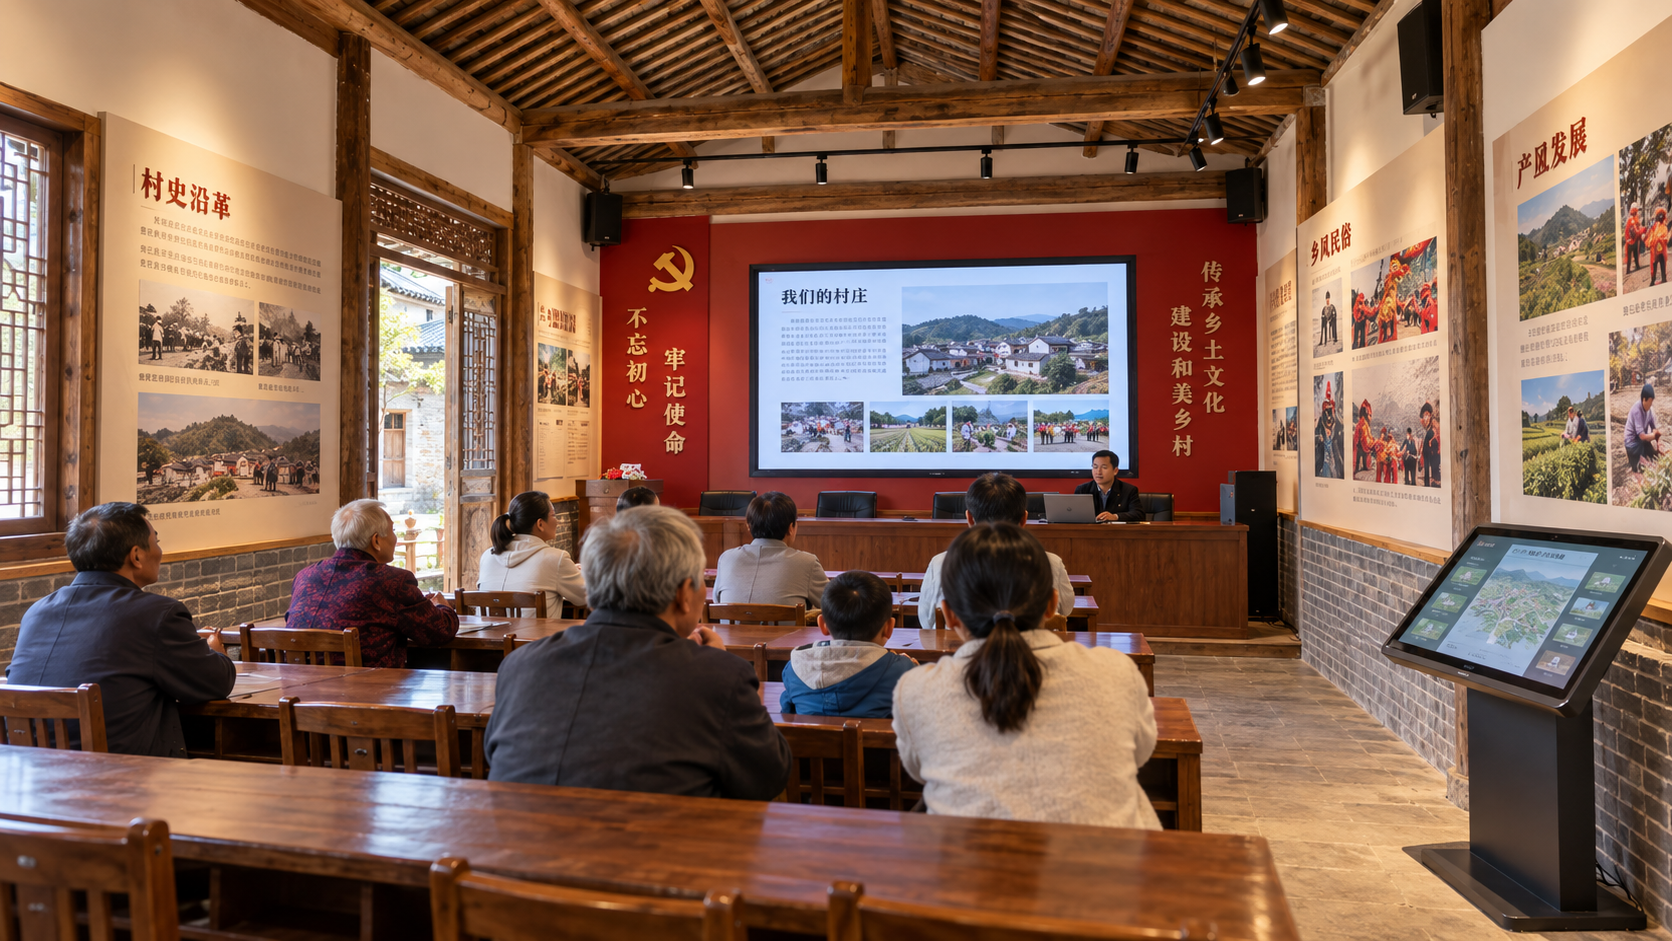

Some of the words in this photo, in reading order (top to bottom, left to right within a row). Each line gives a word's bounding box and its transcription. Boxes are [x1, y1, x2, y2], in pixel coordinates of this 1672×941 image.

[141, 167, 231, 220] 村史沿革
[1311, 222, 1352, 267] 乡风民俗
[781, 287, 868, 306] 我们的村庄
[1201, 260, 1225, 414] 传承乡土文化
[626, 307, 648, 409] 不忘初心
[663, 347, 686, 455] 牢记使命
[1170, 305, 1193, 457] 建设和美乡村
